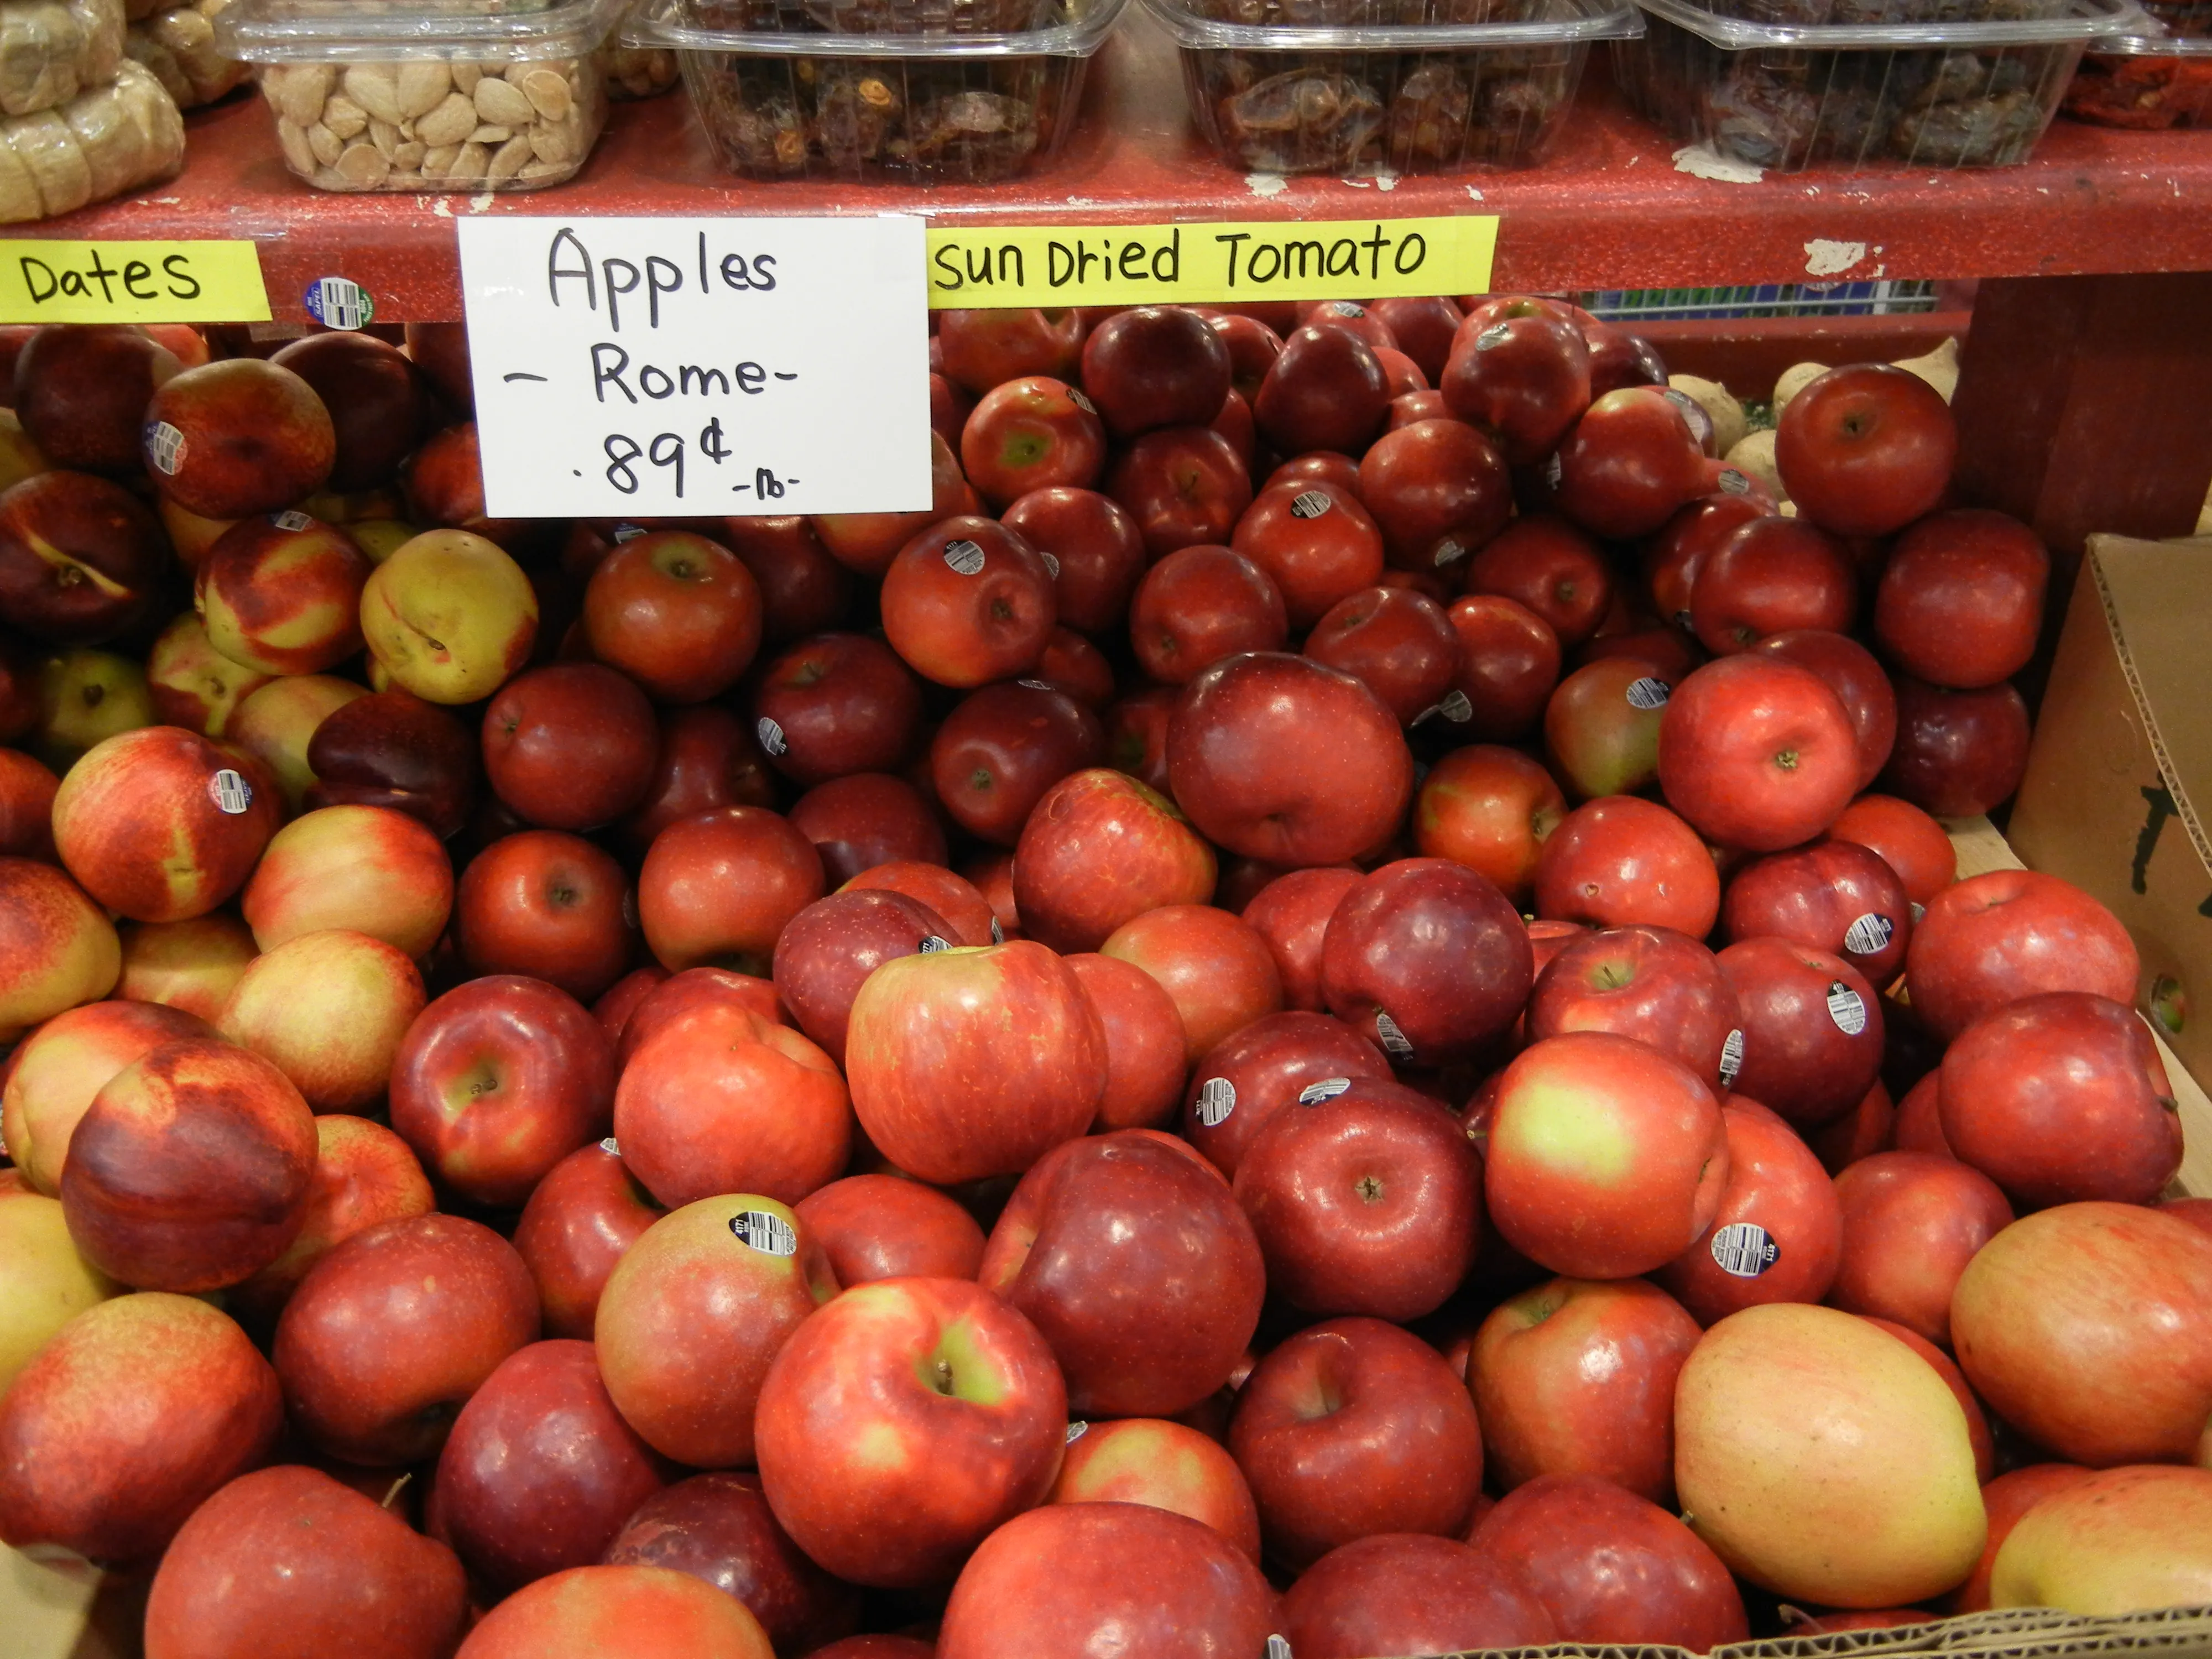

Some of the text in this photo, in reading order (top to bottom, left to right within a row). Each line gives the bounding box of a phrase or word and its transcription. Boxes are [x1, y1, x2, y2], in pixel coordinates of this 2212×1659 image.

[20, 249, 200, 304] Dates
[549, 228, 776, 332] Apples
[1048, 228, 1179, 287] Dried
[1215, 225, 1426, 287] Tomato
[734, 1219, 744, 1234] 4171
[1766, 1244, 1775, 1261] 4171
